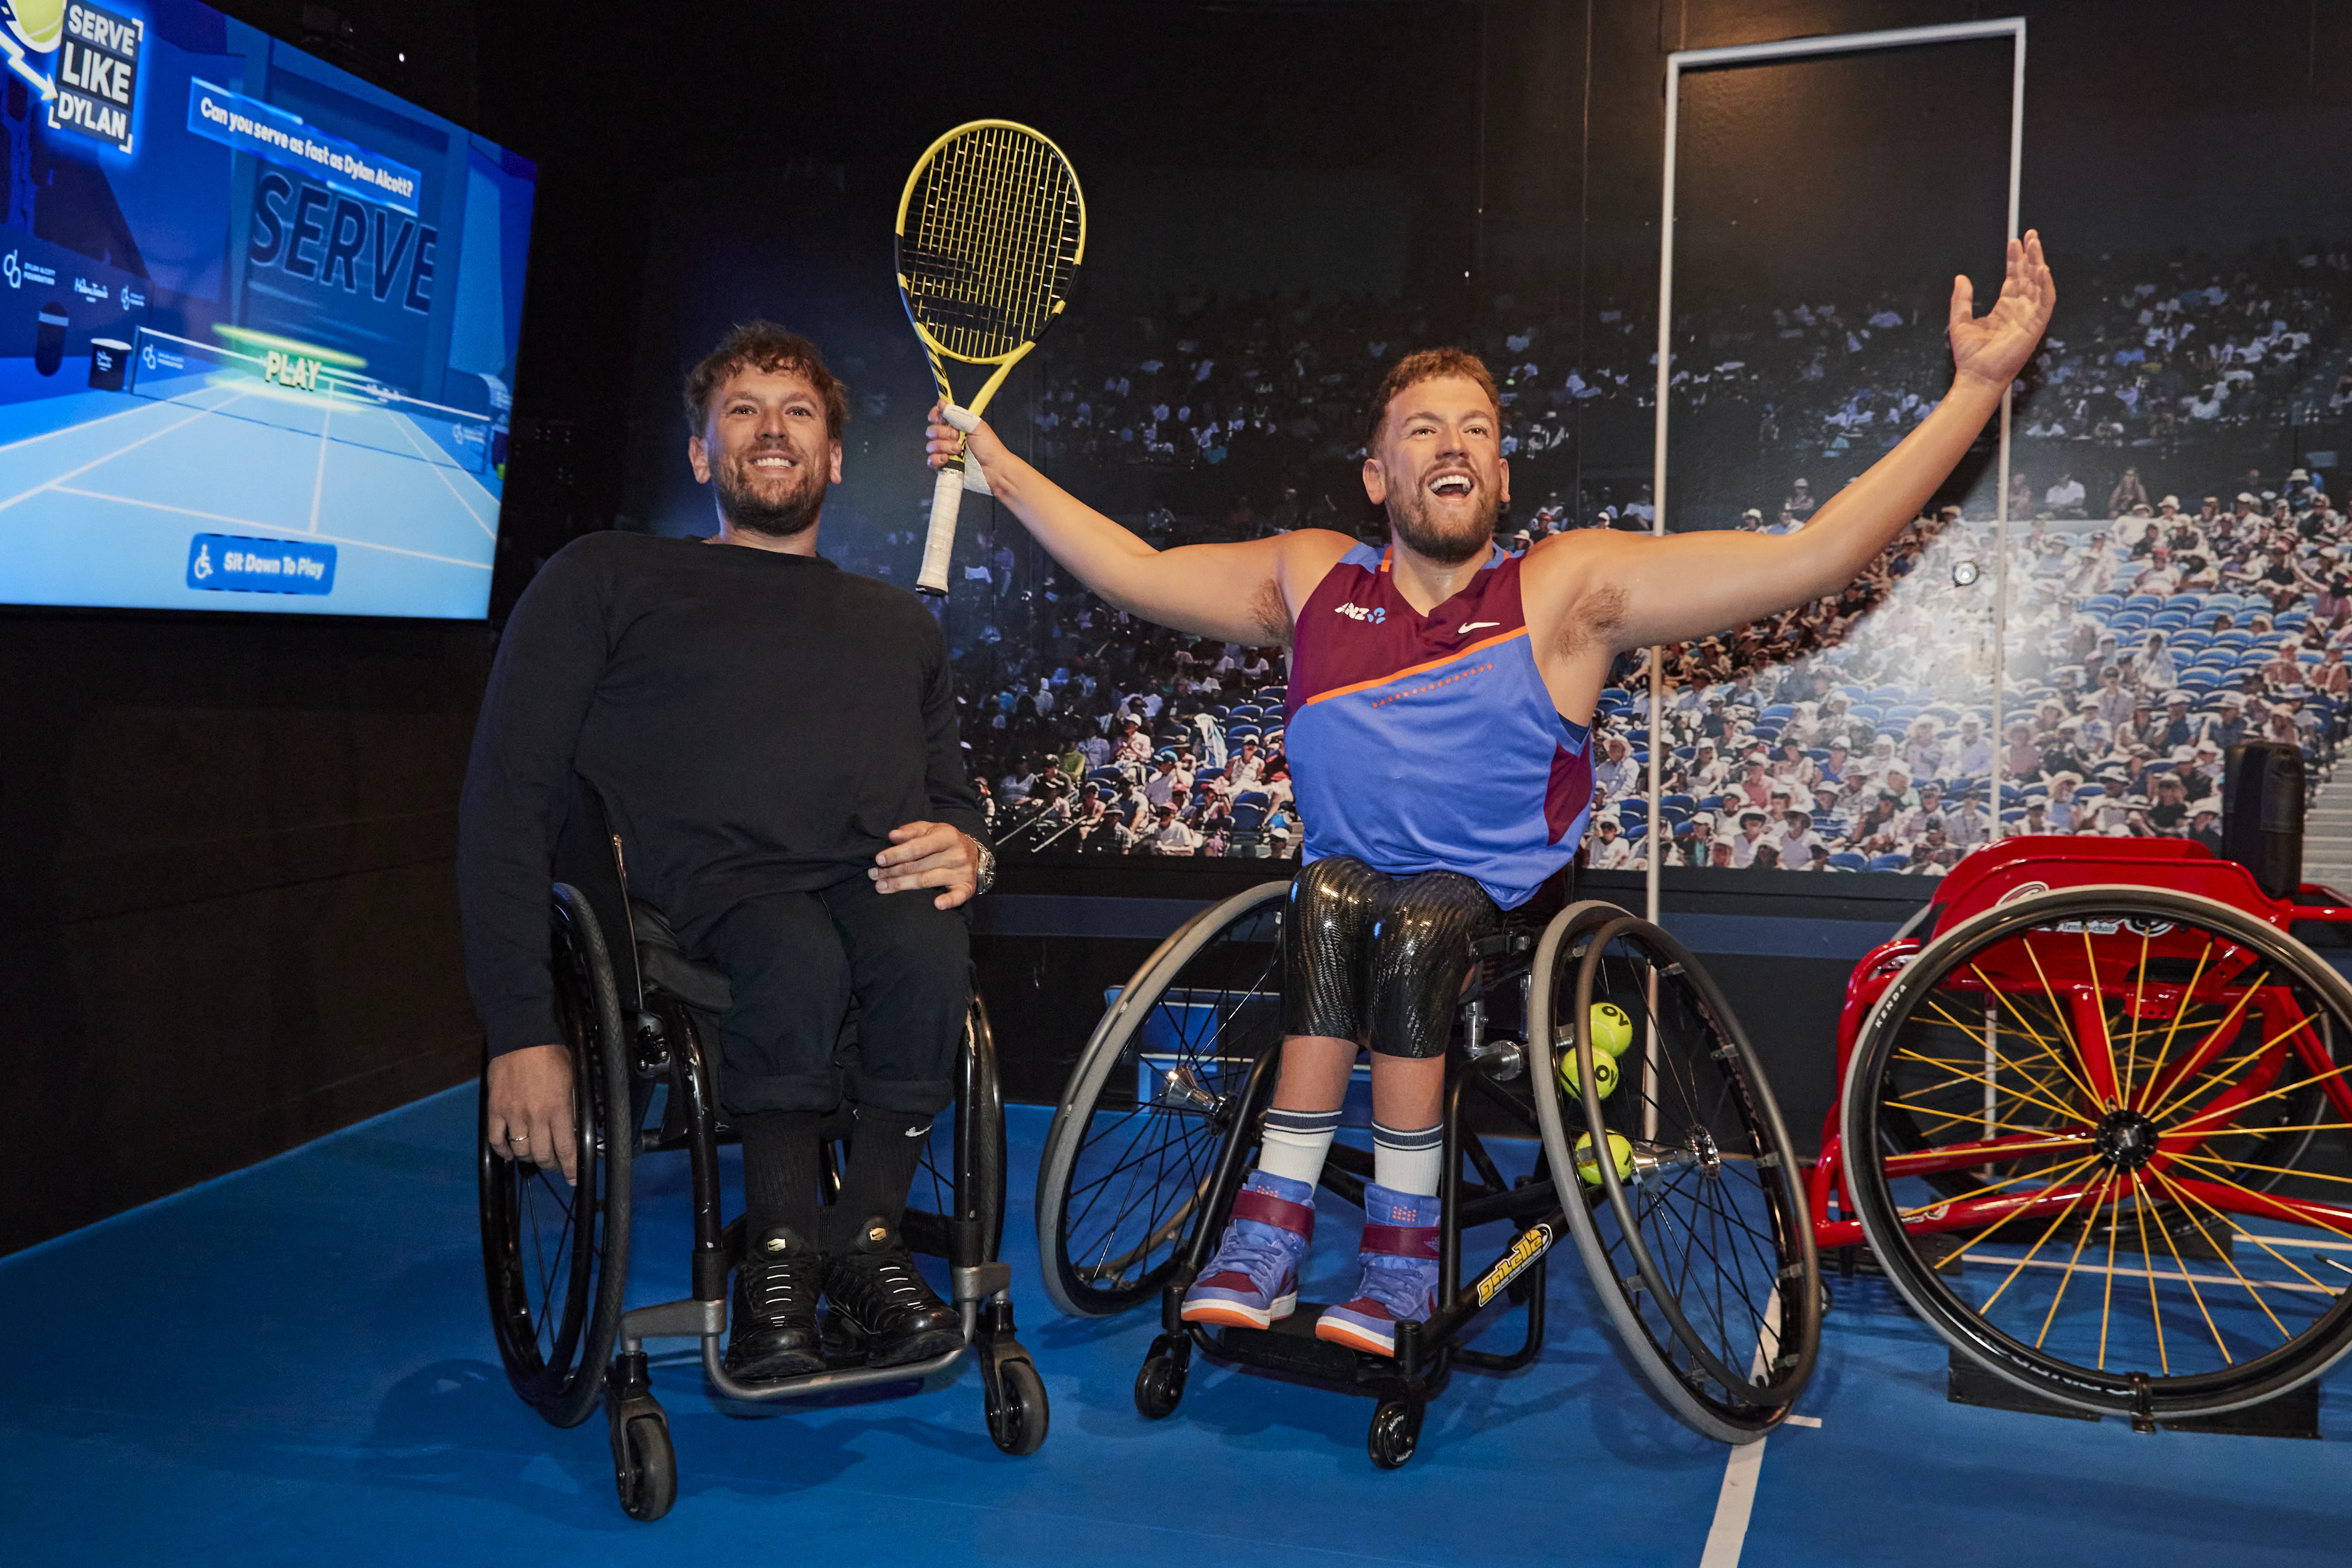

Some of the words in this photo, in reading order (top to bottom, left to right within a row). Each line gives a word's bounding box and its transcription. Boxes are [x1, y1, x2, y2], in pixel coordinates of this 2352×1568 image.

[68, 4, 135, 56] SERVE
[62, 41, 131, 104] LIKE
[58, 92, 127, 140] DYLAN
[201, 97, 228, 125] Can
[229, 112, 253, 135] you
[254, 122, 288, 148] serve
[289, 137, 304, 155] as
[305, 139, 329, 165] fast
[329, 153, 343, 171] as
[344, 154, 375, 183] Dylan
[375, 168, 413, 198] Alcott?
[251, 171, 437, 315] SERVE
[265, 350, 322, 392] PLAY
[224, 551, 243, 571] Sit
[245, 553, 280, 573] Down
[282, 556, 296, 575] To
[297, 557, 325, 580] Play
[1335, 602, 1370, 620] ANZ
[1875, 984, 1907, 1028] KENDA
